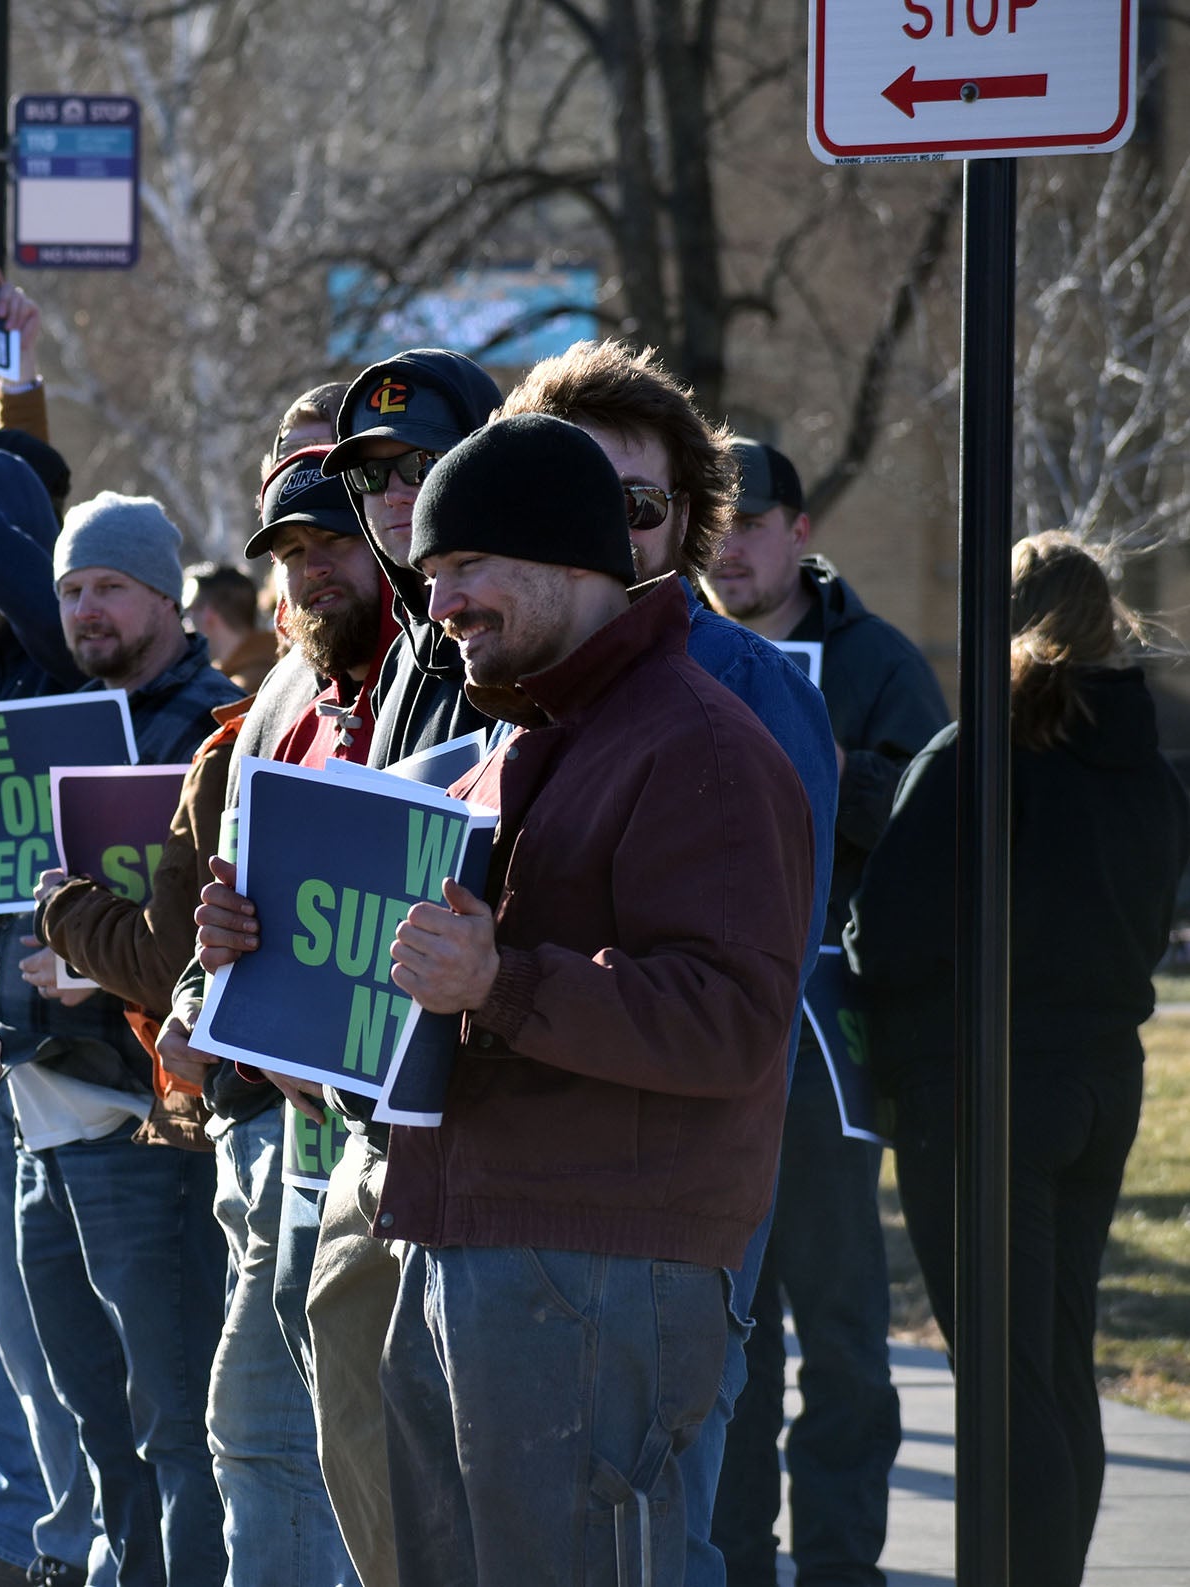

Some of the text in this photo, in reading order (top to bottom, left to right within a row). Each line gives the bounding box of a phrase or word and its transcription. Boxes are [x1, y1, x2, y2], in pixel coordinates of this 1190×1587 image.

[25, 102, 133, 122] BUS STOP
[405, 808, 468, 902] W
